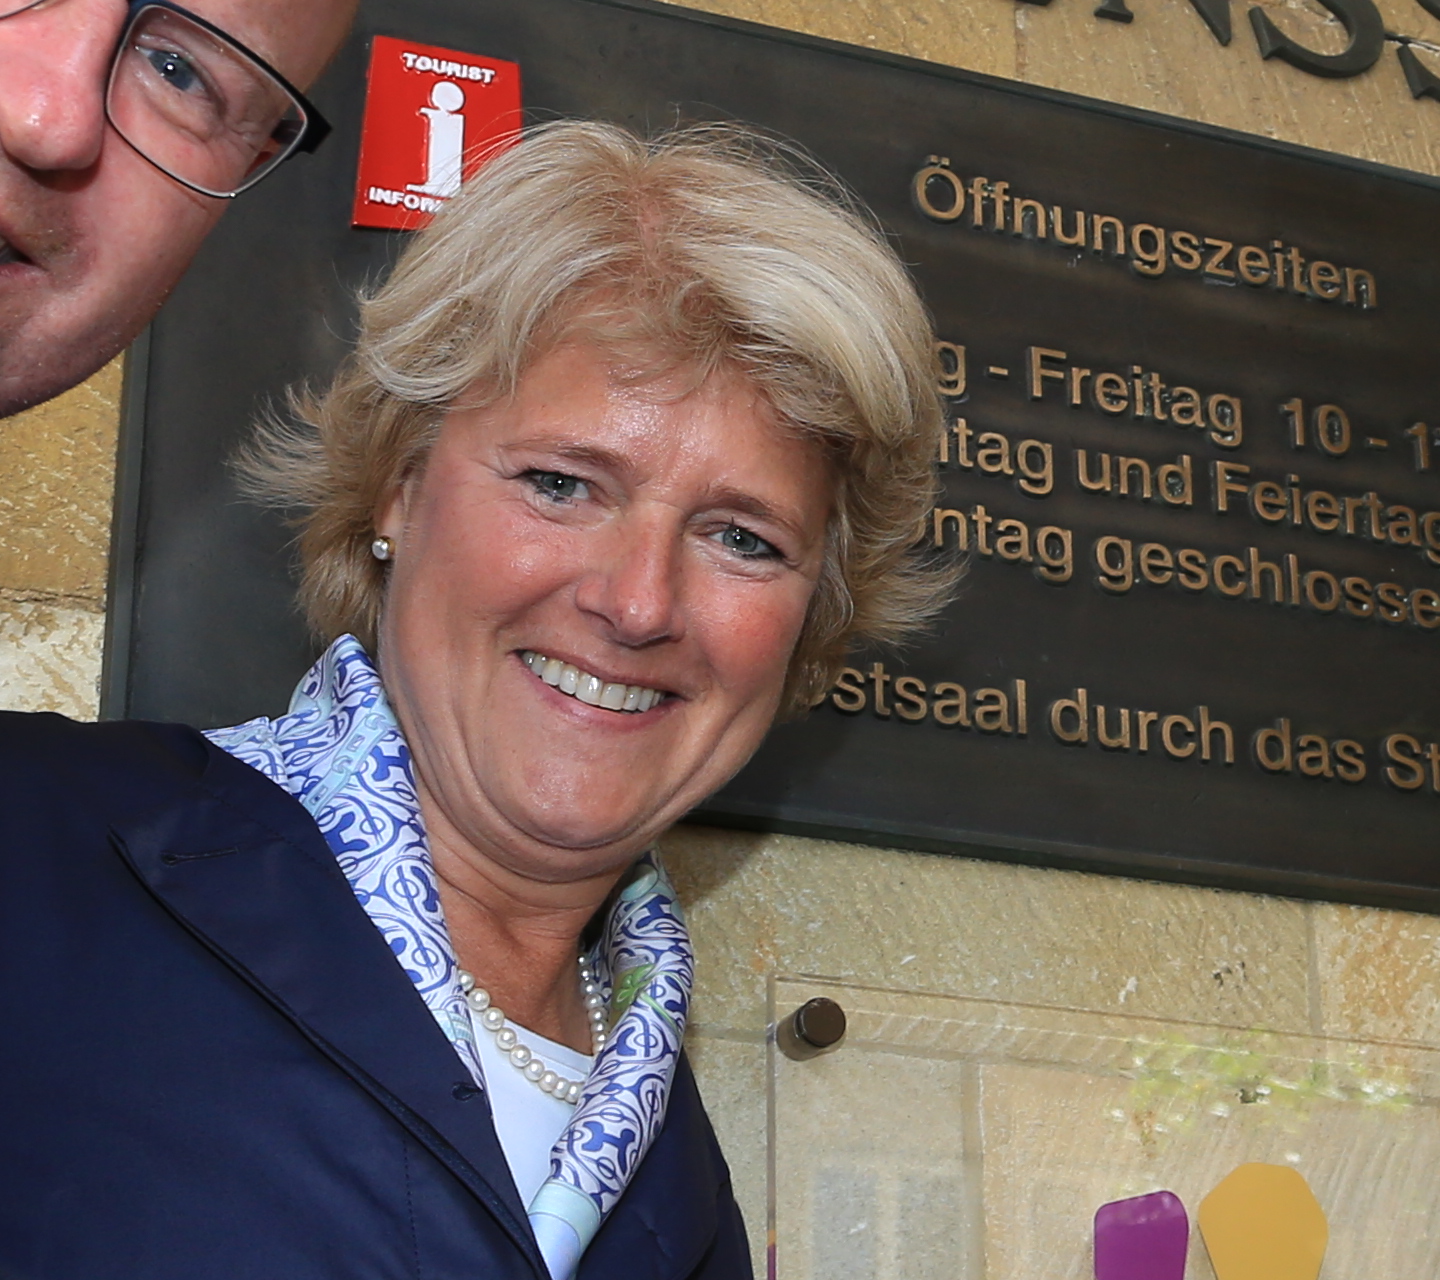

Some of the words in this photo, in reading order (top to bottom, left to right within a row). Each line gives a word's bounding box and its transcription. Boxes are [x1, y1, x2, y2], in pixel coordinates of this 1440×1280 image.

[402, 52, 496, 84] TOURIST
[915, 155, 1378, 309] Öffnungszeiten
[1028, 346, 1243, 448] Freitag
[1280, 397, 1352, 456] 10
[1077, 448, 1193, 507] und
[920, 504, 1073, 584] ntag
[810, 662, 1028, 736] stsaal
[1050, 687, 1235, 765] durch
[1255, 718, 1367, 783] das
